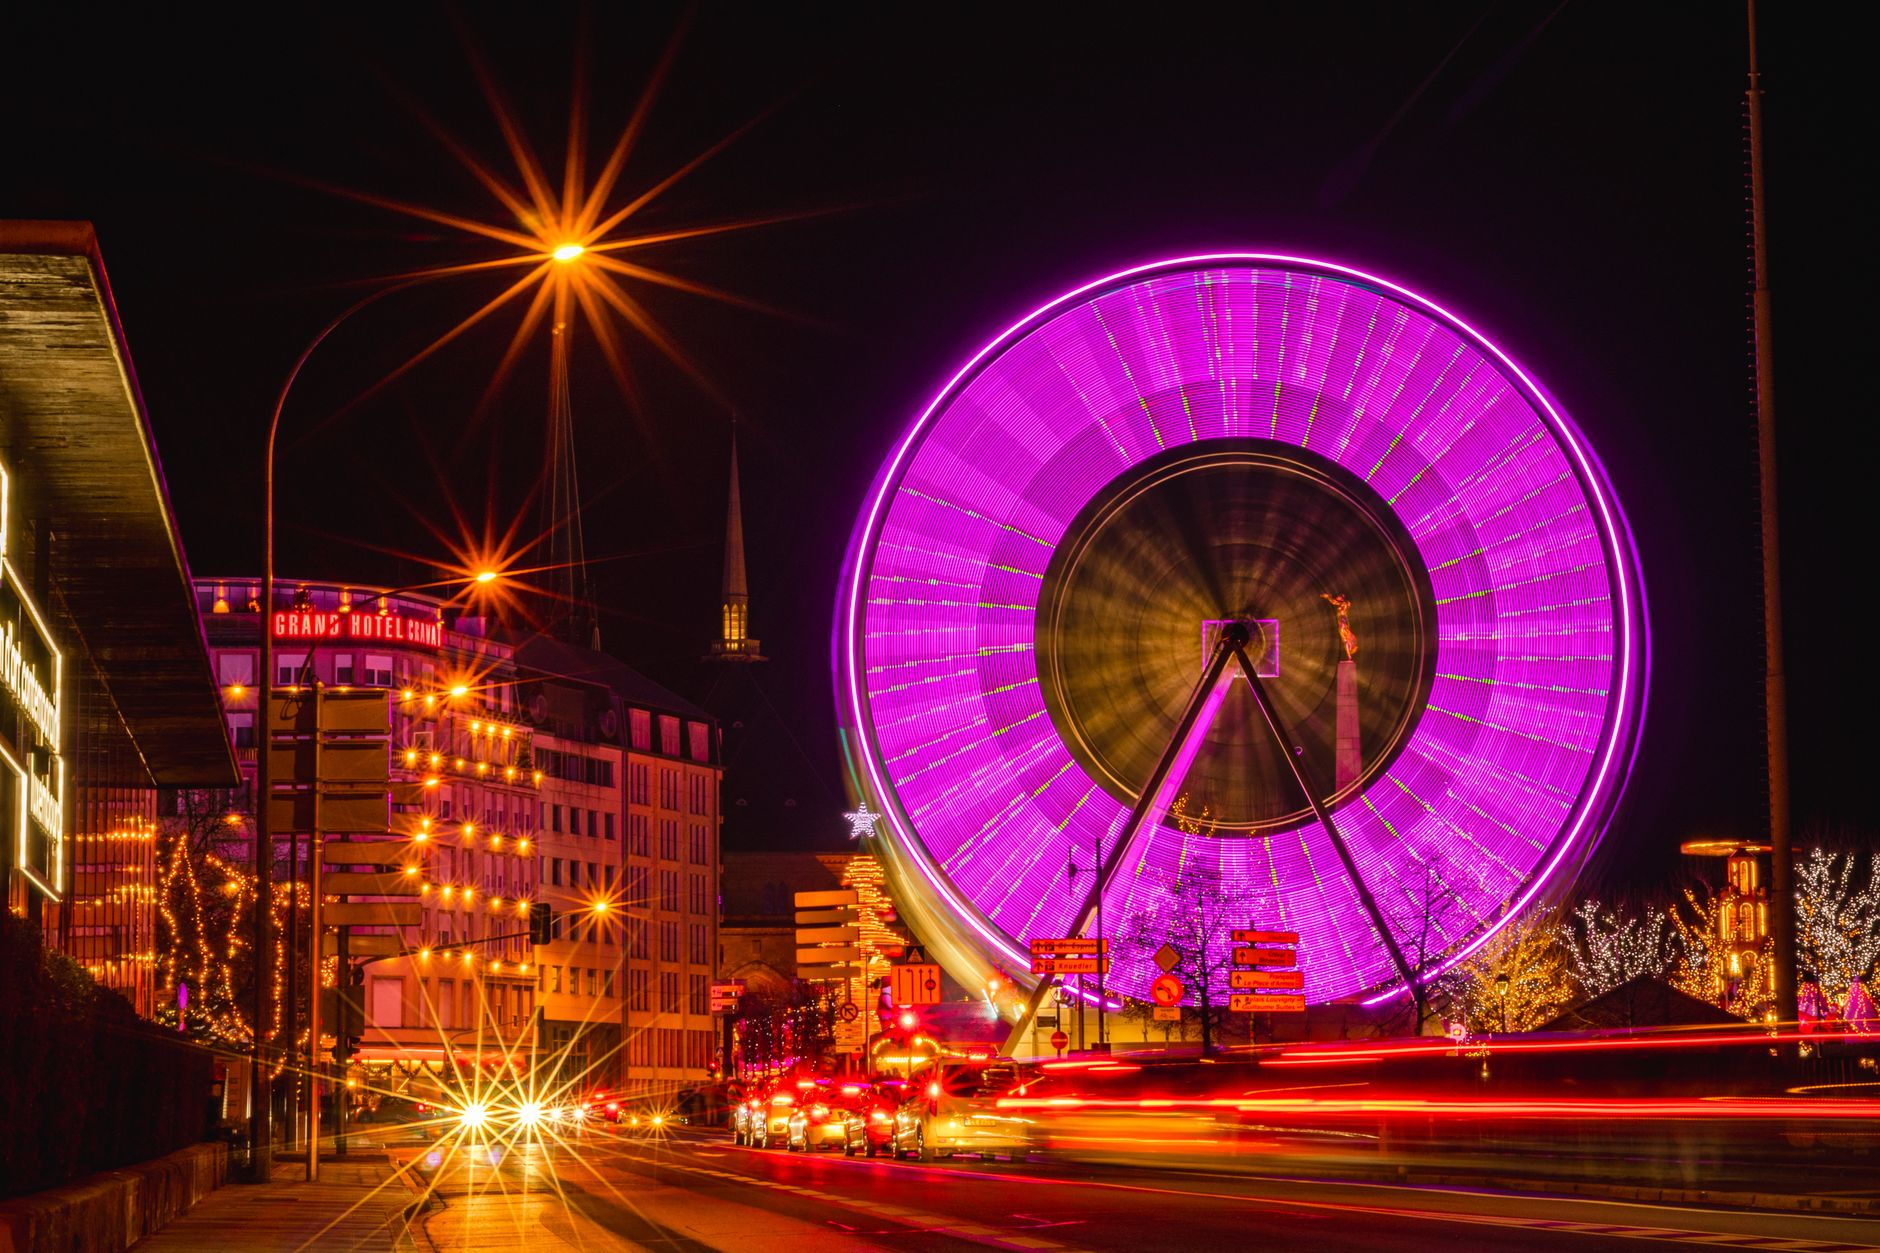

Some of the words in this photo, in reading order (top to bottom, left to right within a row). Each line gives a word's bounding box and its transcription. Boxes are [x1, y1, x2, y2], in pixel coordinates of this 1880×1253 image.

[275, 613, 340, 636] GRAND
[351, 614, 403, 639] HOTEL
[407, 618, 442, 647] CRAVAT
[1058, 962, 1093, 970] Knuedler
